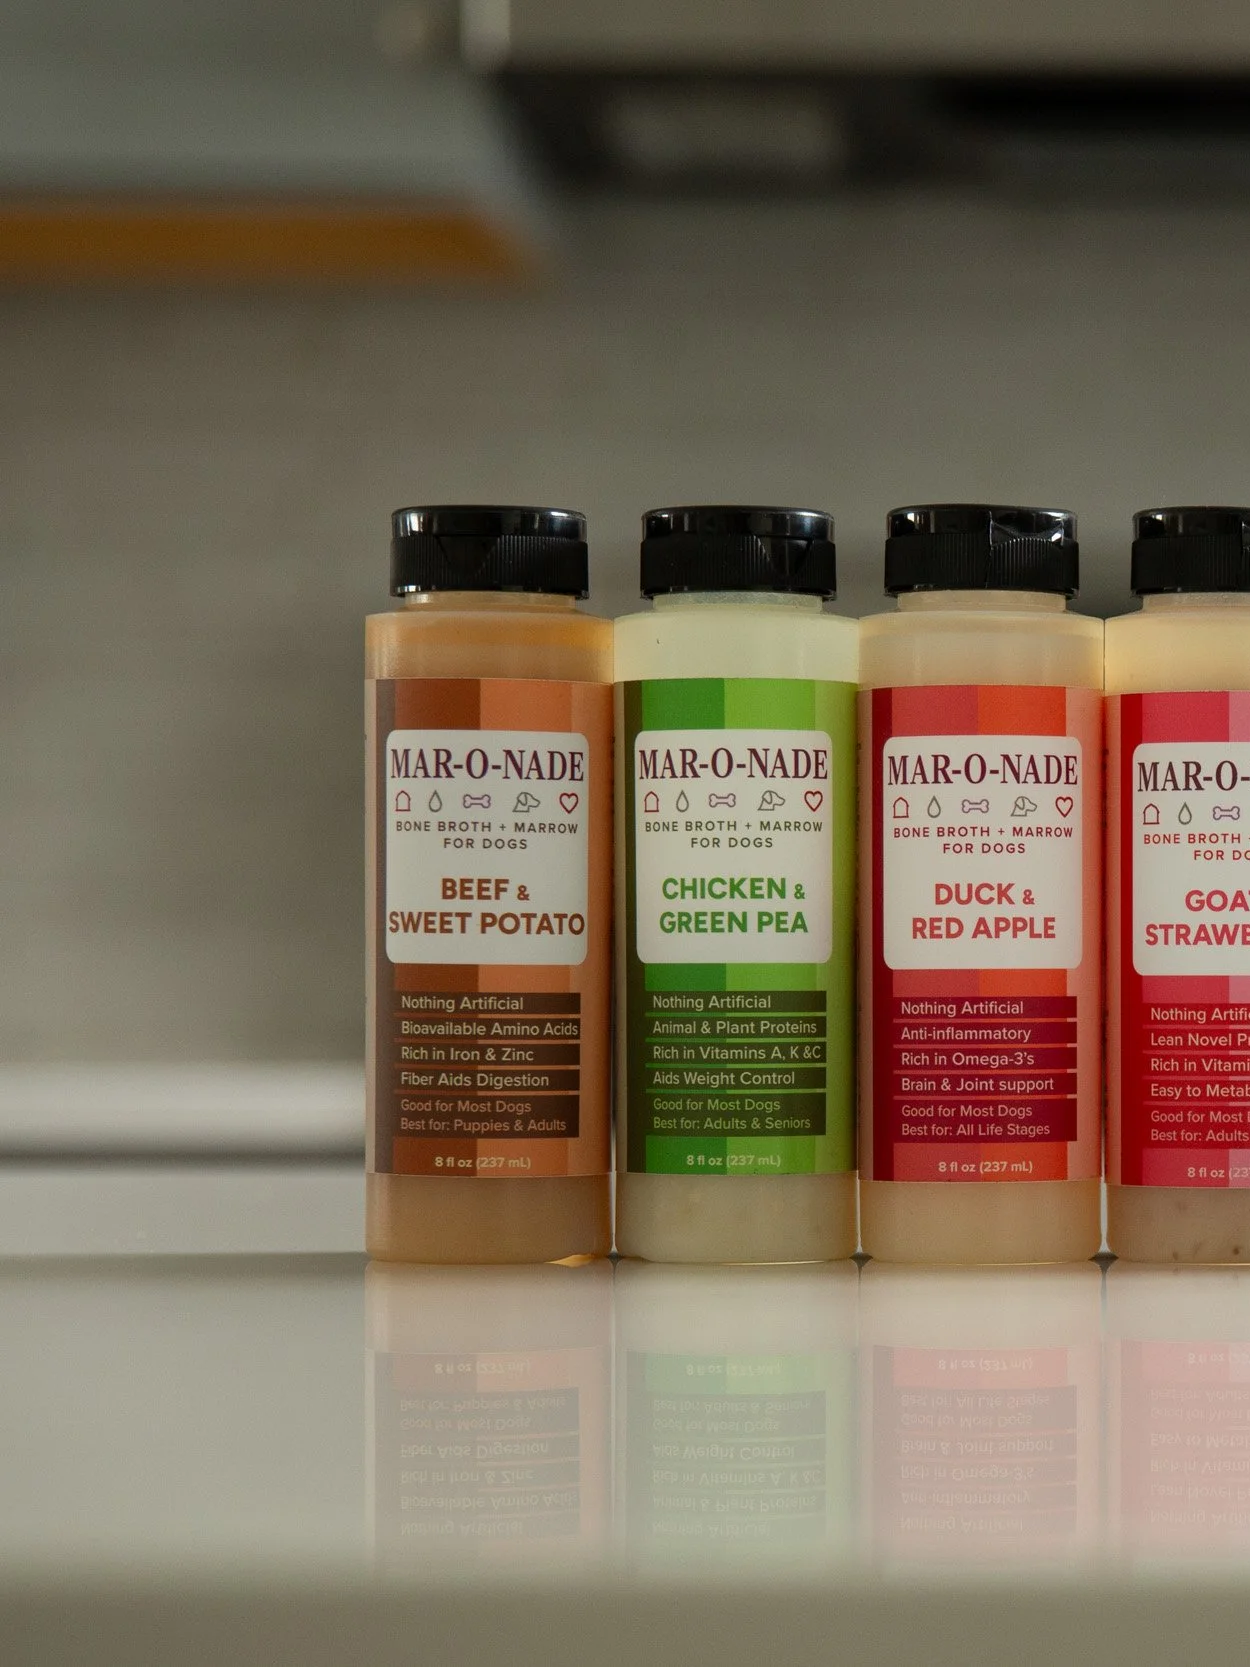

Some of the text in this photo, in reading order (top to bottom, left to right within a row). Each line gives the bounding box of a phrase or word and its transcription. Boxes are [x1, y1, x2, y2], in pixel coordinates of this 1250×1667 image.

[391, 749, 583, 781] MAR-O-NADE
[639, 748, 827, 779] MAR-O-NADE
[888, 754, 1077, 785] MAR-O-NADE
[397, 821, 430, 831] BONE
[438, 821, 491, 832] BROTH
[515, 822, 578, 833] MARROW
[444, 838, 527, 849] FOR DOGS
[1144, 834, 1180, 844] BONE
[1188, 833, 1240, 844] BROTH
[1194, 850, 1224, 860] FOR
[442, 878, 529, 900] BEEF &
[662, 877, 805, 899] CHICKEN &
[935, 883, 1035, 905] DUCK &
[389, 911, 584, 935] SWEET POTATO
[660, 912, 808, 933] GREEN PEA
[913, 917, 1055, 939] RED APPLE
[402, 996, 523, 1012] Nothing Artificial
[653, 995, 770, 1011] Nothing Artificial
[902, 1001, 1023, 1017] Nothing Artificial
[1151, 1008, 1206, 1024] Nothing
[402, 1021, 578, 1035] Bioavailable Amino Acids
[653, 1021, 816, 1033] Animal & Plant Proteins
[901, 1027, 1031, 1043] Anti-inflammatory
[1151, 1033, 1183, 1046] Lean
[1188, 1033, 1231, 1046] Novel
[402, 1047, 533, 1061] Rich in Iron & Zinc
[654, 1046, 678, 1059] Rich
[684, 1046, 695, 1059] in
[699, 1047, 766, 1059] Vitamins
[902, 1053, 929, 1065] Rich
[935, 1053, 946, 1065] in
[1151, 1058, 1179, 1071] Rich
[1185, 1059, 1196, 1071] in
[402, 1072, 549, 1089] Fiber Aids Digestion
[653, 1072, 794, 1088] Aids Weight Control
[902, 1078, 1053, 1093] Brain & Joint support
[1151, 1084, 1182, 1100] Easy
[1186, 1085, 1201, 1097] to
[654, 1098, 780, 1113] Good for Most Dogs
[654, 1117, 810, 1129] Best for: Adults & Seniors
